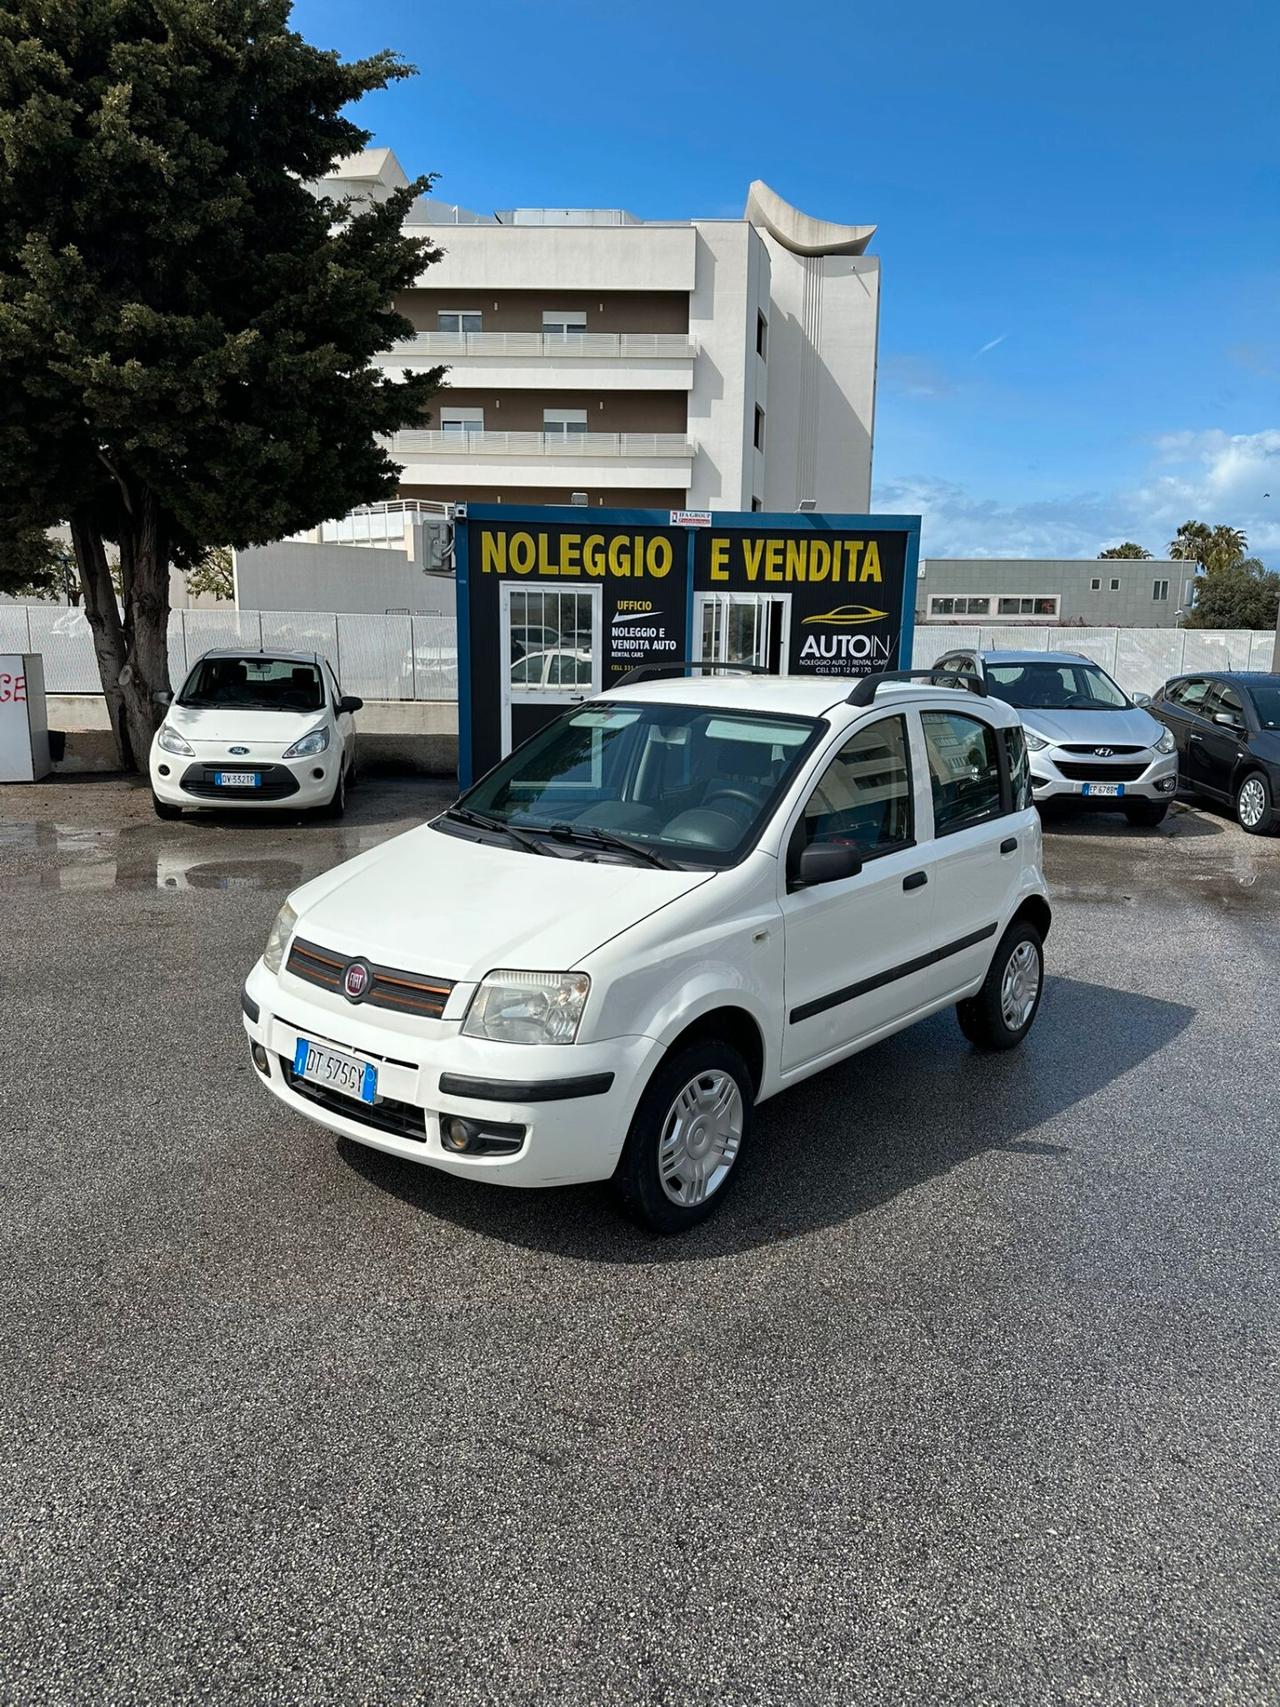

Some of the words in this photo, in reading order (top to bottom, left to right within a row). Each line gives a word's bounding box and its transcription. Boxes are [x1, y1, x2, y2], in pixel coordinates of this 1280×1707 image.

[481, 531, 673, 578] NOLEGGIO
[710, 538, 731, 581] E
[742, 539, 882, 582] VENDITA
[617, 600, 652, 611] UFFICIO
[611, 627, 657, 638] NOLEGGIO
[659, 628, 666, 638] E
[611, 640, 650, 650] VENDITA
[652, 641, 677, 651] AUTO
[348, 972, 364, 990] FIAT
[306, 1048, 324, 1074] DT
